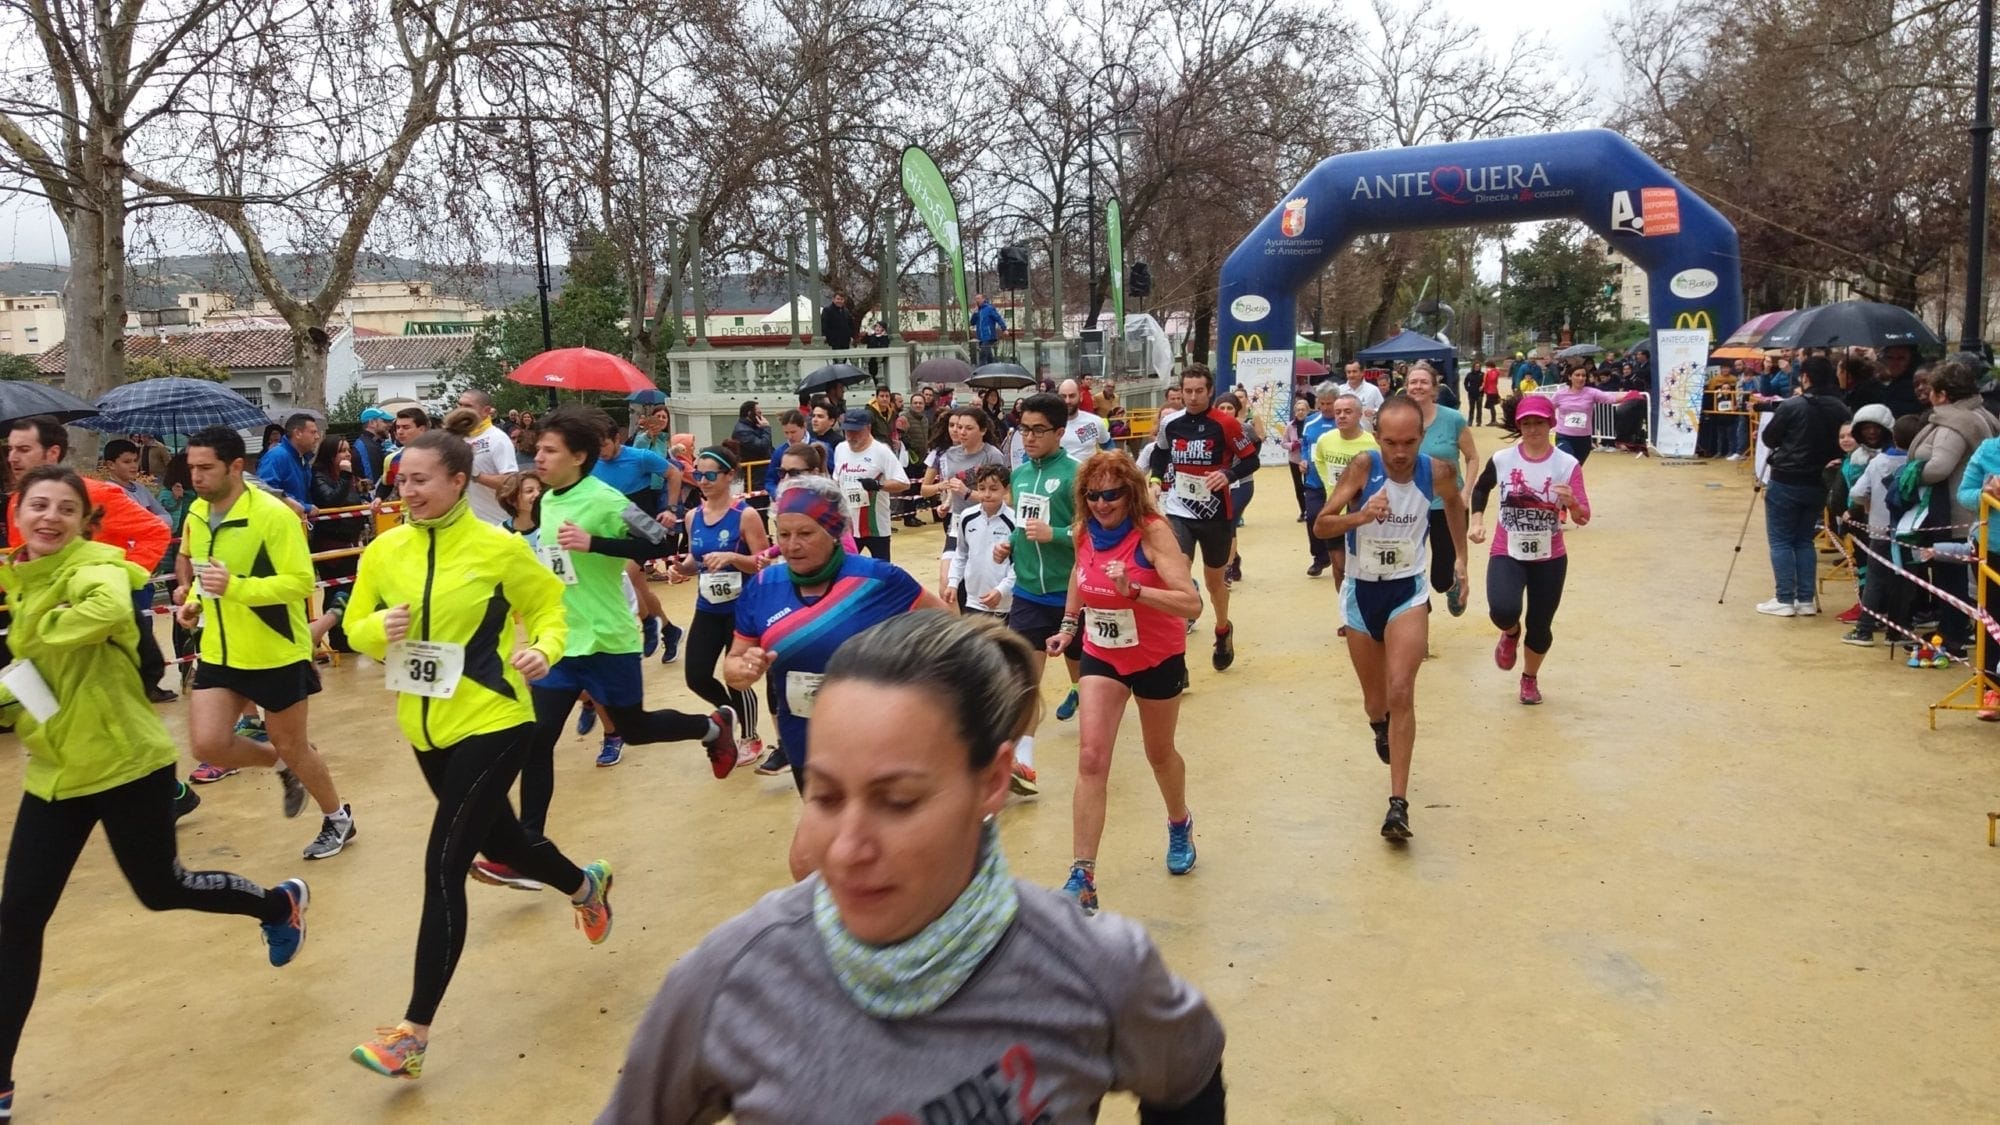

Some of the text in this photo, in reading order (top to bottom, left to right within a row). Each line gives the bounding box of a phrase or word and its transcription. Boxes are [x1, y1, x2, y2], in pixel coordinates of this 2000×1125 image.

[1351, 162, 1550, 204] ANTEQUERA
[1475, 193, 1510, 203] Directa
[1534, 187, 1574, 199] corazón
[1264, 238, 1324, 247] Ayuntamiento
[1264, 247, 1322, 256] de Antequera
[1240, 357, 1290, 365] ANTEQUERA
[1189, 483, 1196, 494] 9
[1021, 505, 1040, 519] 116
[1387, 513, 1418, 524] Eladio
[1521, 541, 1538, 554] 38
[1379, 550, 1396, 566] 18
[709, 583, 732, 597] 136
[1094, 621, 1119, 639] 178
[410, 658, 437, 682] 39
